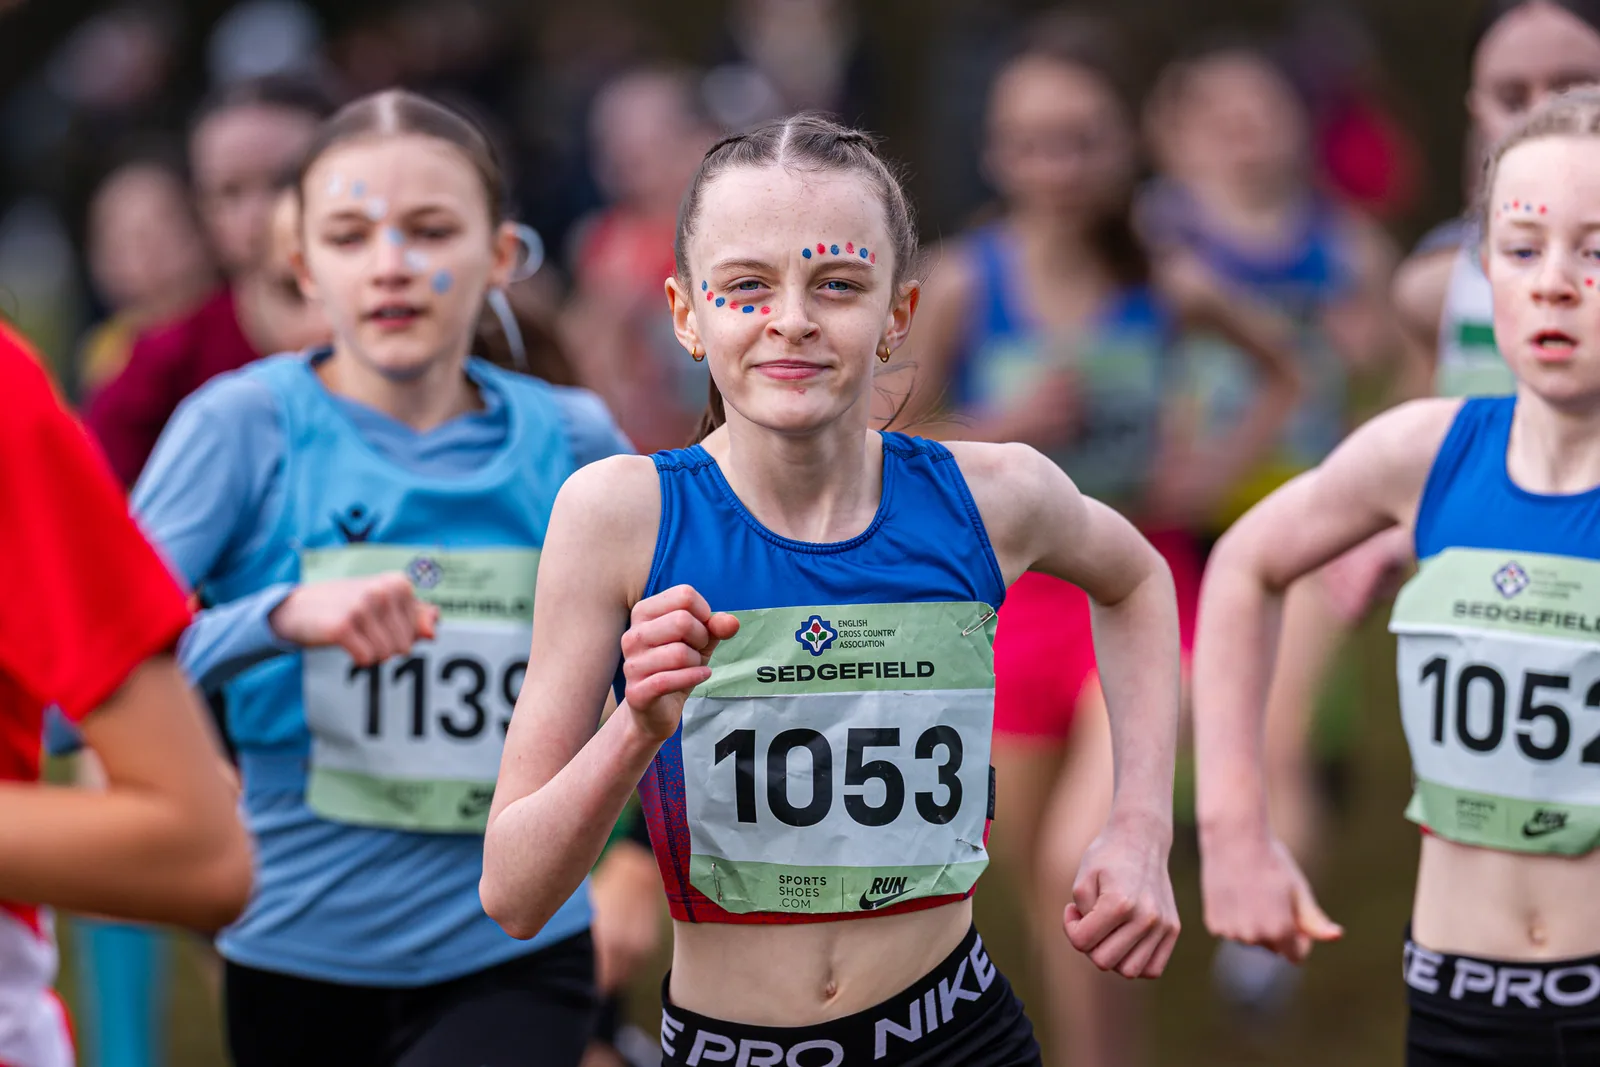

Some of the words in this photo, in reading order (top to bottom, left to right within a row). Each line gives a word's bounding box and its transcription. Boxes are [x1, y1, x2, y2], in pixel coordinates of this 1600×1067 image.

[838, 619, 868, 628] ENGLISH
[1453, 601, 1600, 632] SEDGEFIEL
[838, 629, 862, 638] CROSS
[863, 629, 897, 638] COUNTRY
[839, 640, 885, 649] ASSOCIATION
[756, 661, 935, 683] SEDGEFIELD
[714, 725, 964, 827] 1053
[779, 874, 827, 886] SPORTS
[869, 876, 909, 895] RUN
[779, 886, 820, 898] SHOES
[778, 898, 811, 909] .COM
[1449, 957, 1600, 1009] PRO
[685, 1029, 845, 1067] PRO
[874, 932, 997, 1060] NIKE
